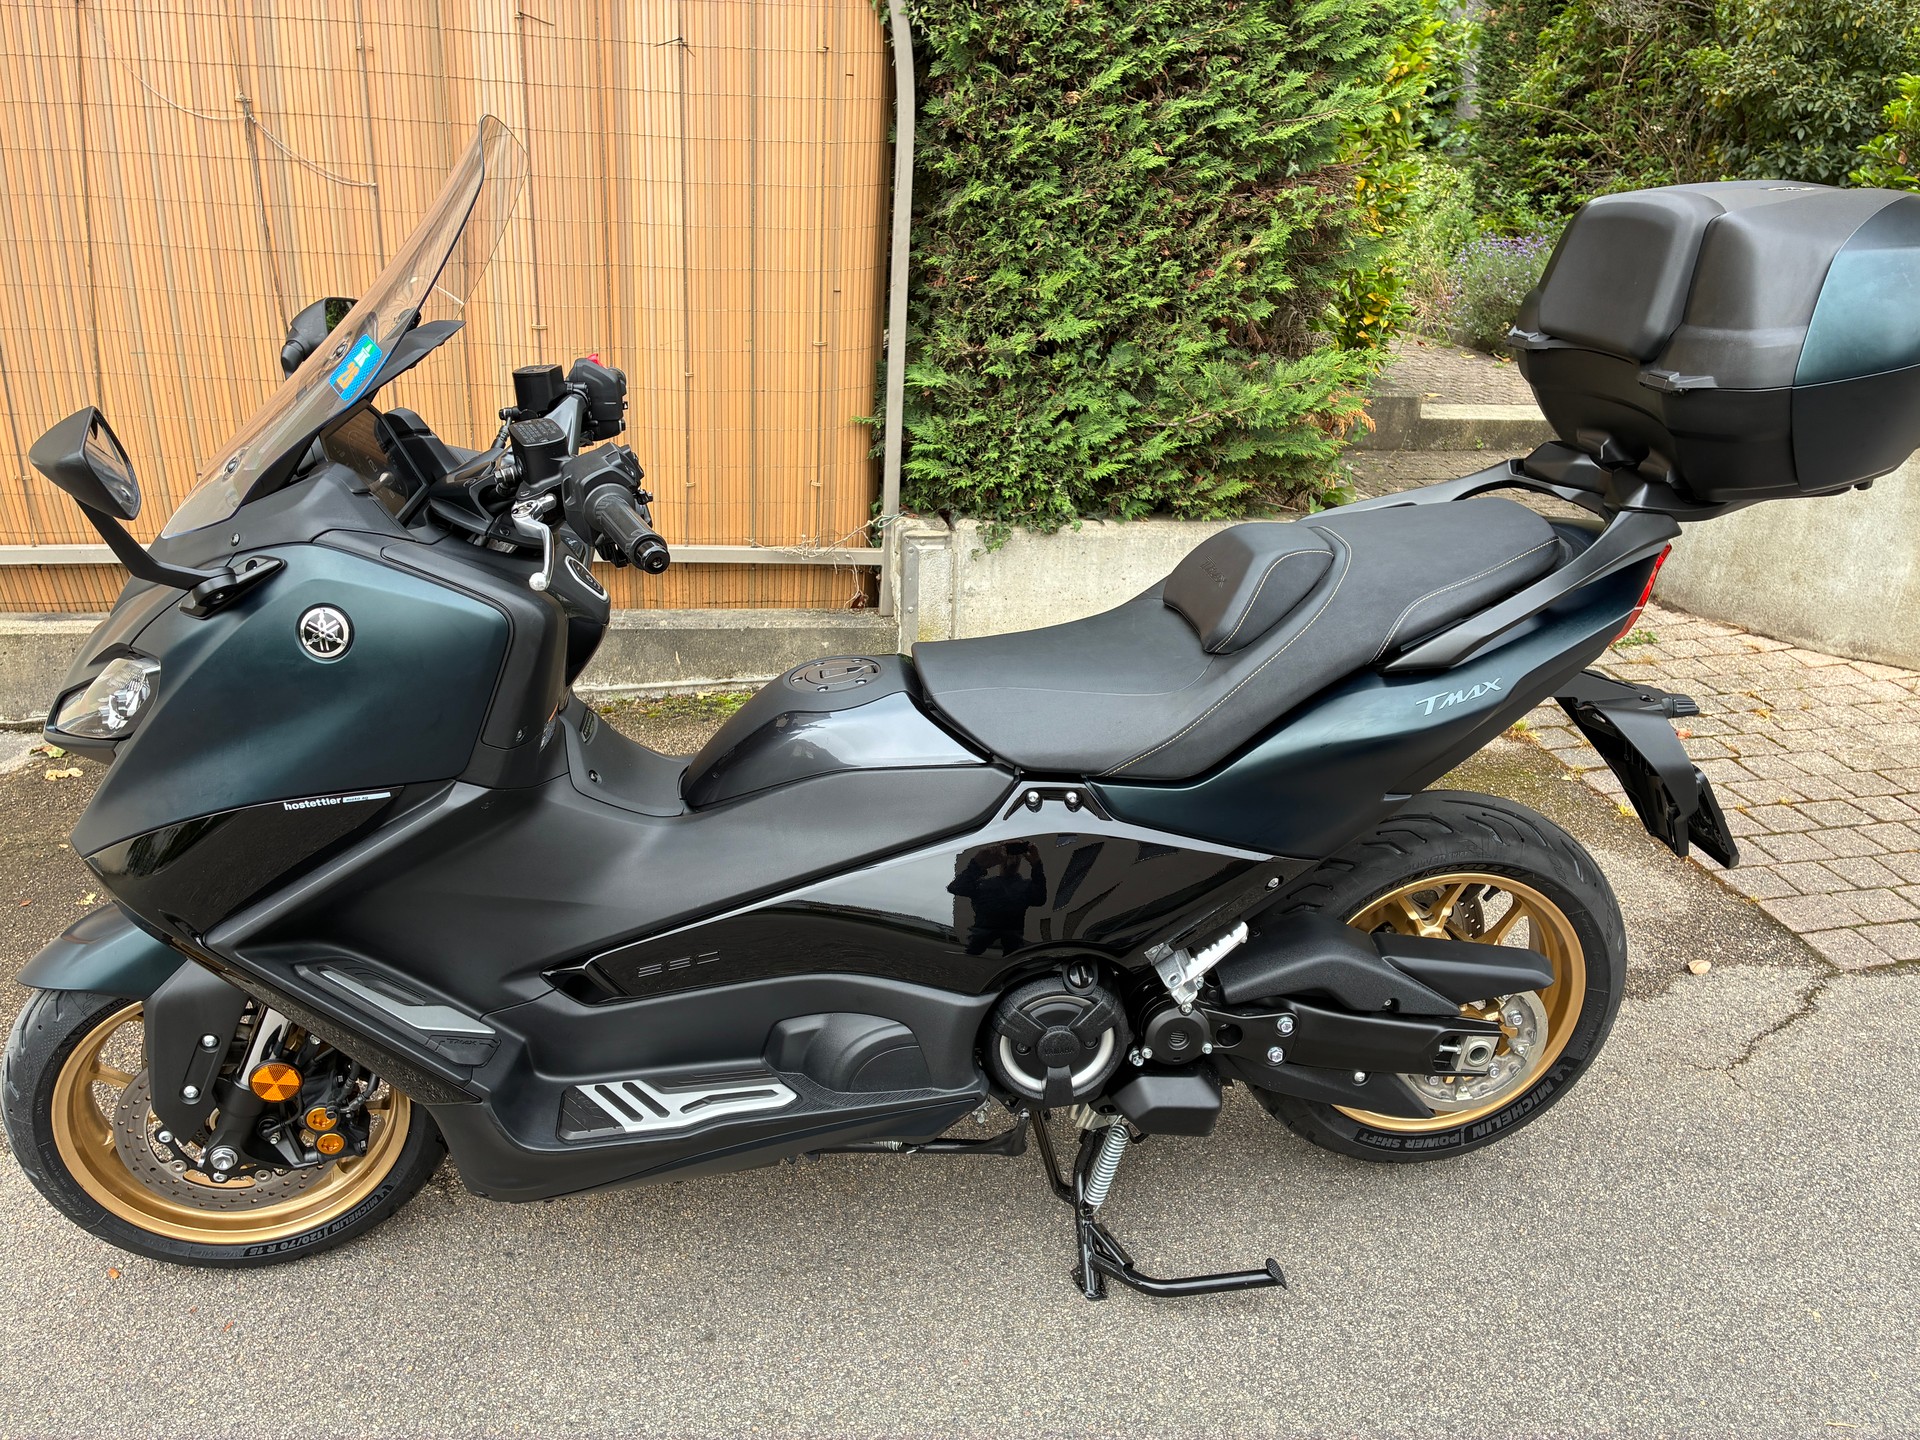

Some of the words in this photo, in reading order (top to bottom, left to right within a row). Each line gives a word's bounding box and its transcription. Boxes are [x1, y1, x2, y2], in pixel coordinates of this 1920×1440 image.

[1415, 677, 1502, 717] TMAX
[283, 797, 342, 811] hostettler
[1472, 1079, 1554, 1139] MICHELIN
[1405, 1129, 1462, 1149] POWER
[331, 1196, 380, 1233] MICHELIN
[266, 1246, 278, 1254] R
[279, 1226, 326, 1251] 120/70
